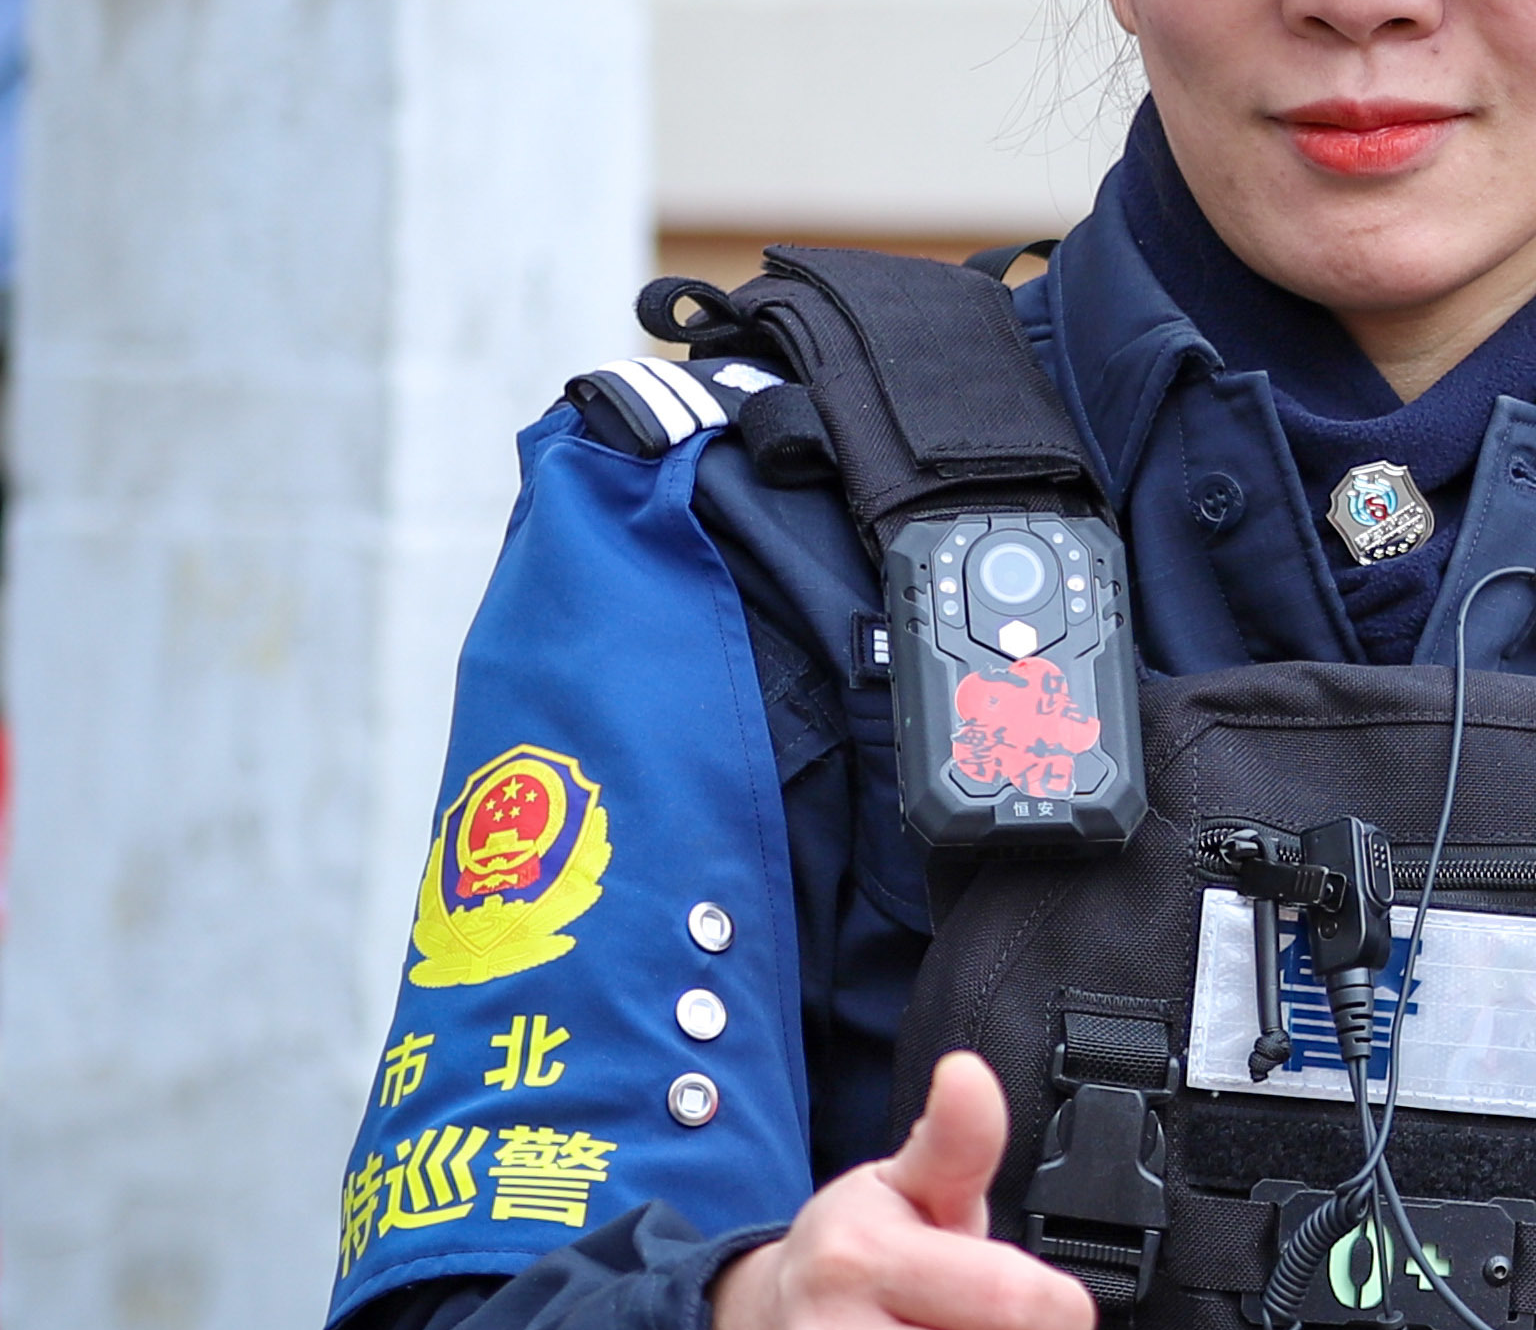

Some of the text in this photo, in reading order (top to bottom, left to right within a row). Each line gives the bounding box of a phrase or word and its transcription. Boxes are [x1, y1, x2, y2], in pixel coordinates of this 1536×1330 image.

[1013, 801, 1054, 818] 恒安
[379, 1015, 571, 1109] 市北
[340, 1123, 618, 1280] 特巡警
